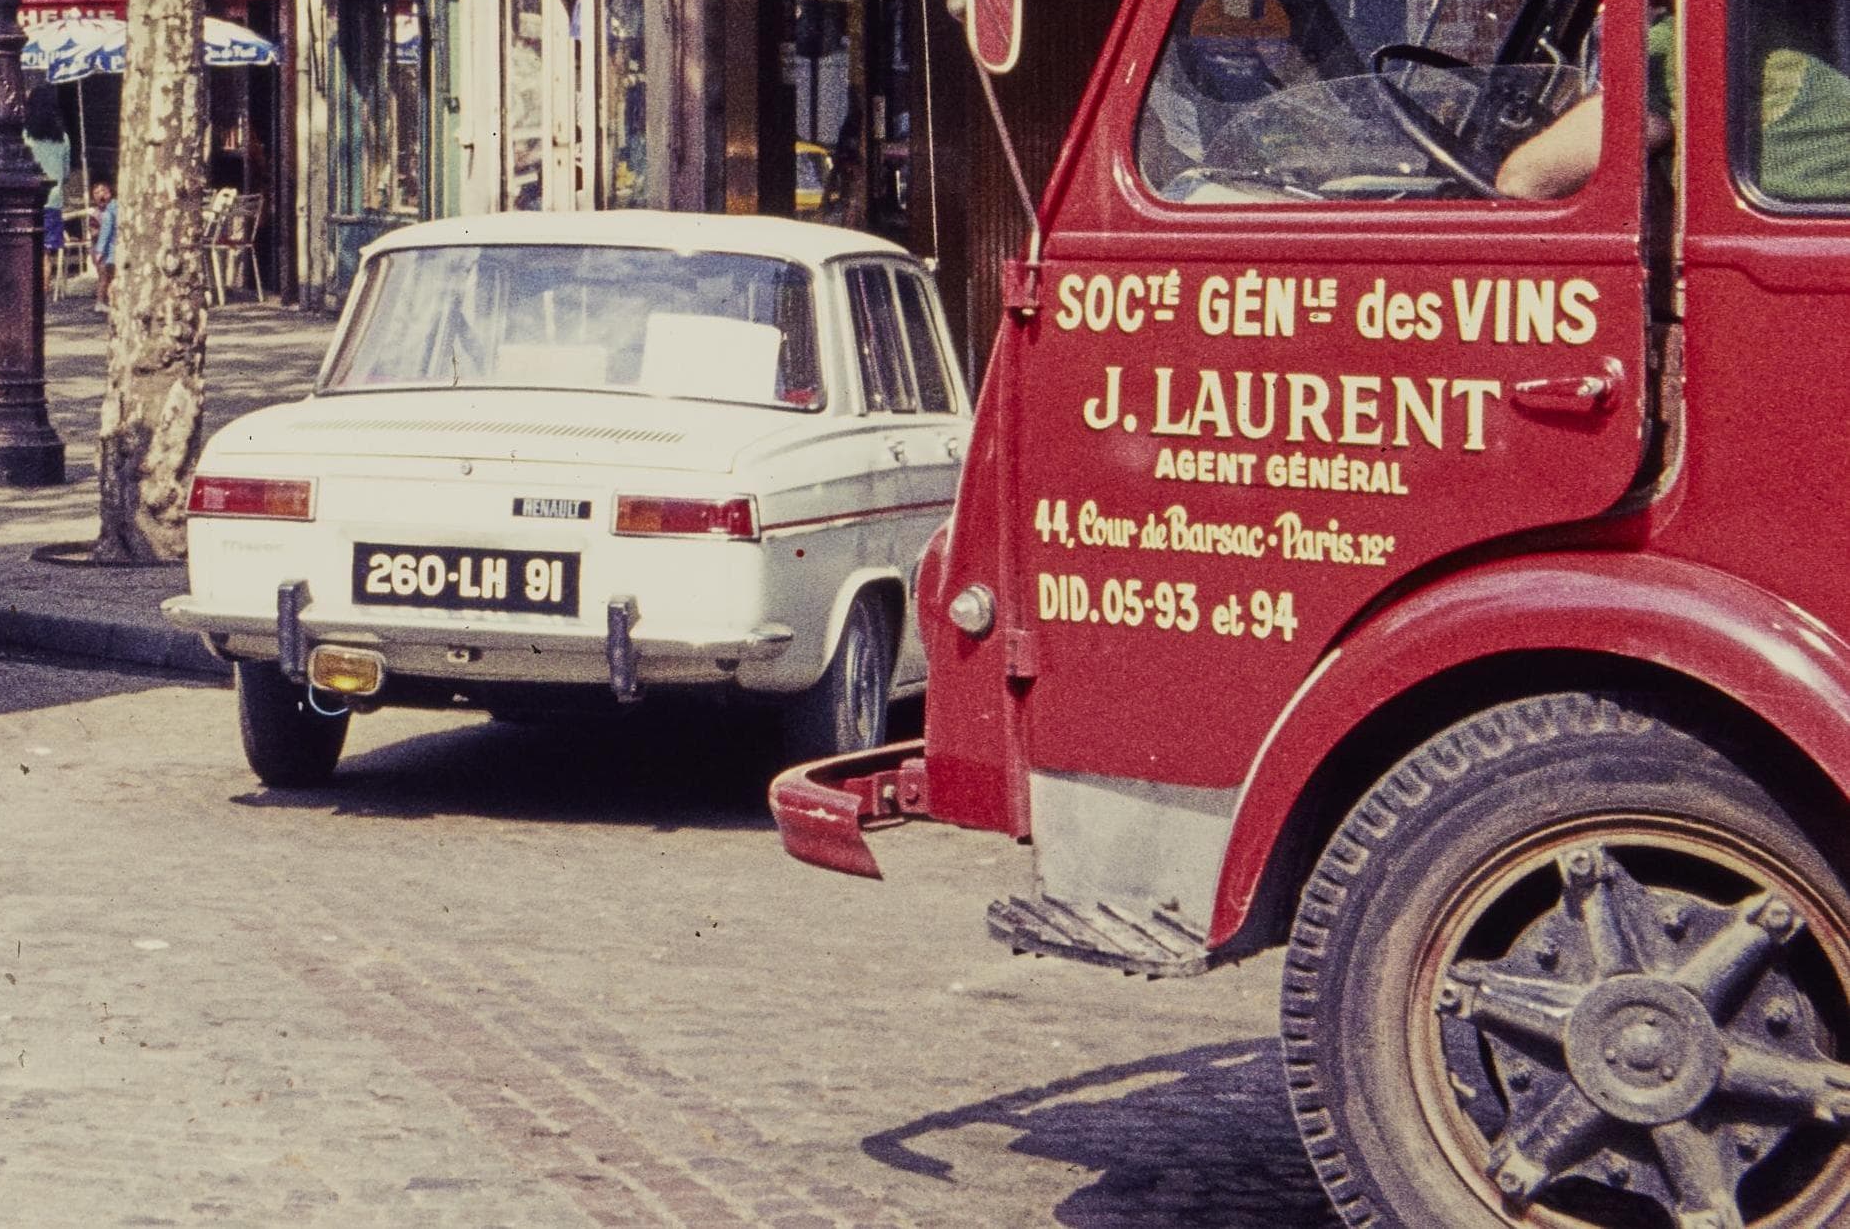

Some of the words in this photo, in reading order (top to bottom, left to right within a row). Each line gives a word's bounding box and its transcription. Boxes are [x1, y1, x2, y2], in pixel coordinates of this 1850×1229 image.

[1356, 278, 1442, 341] des
[1452, 278, 1601, 344] VINS
[1151, 368, 1501, 451] LAURENT
[1154, 447, 1257, 485] AGENT
[1265, 452, 1409, 495] GÉNÉRAL
[522, 498, 582, 519] RENAULT
[1078, 499, 1138, 547] Cour
[1139, 513, 1168, 551] de
[525, 558, 563, 603] 91
[1212, 594, 1246, 637] et
[1250, 589, 1298, 642] 94
